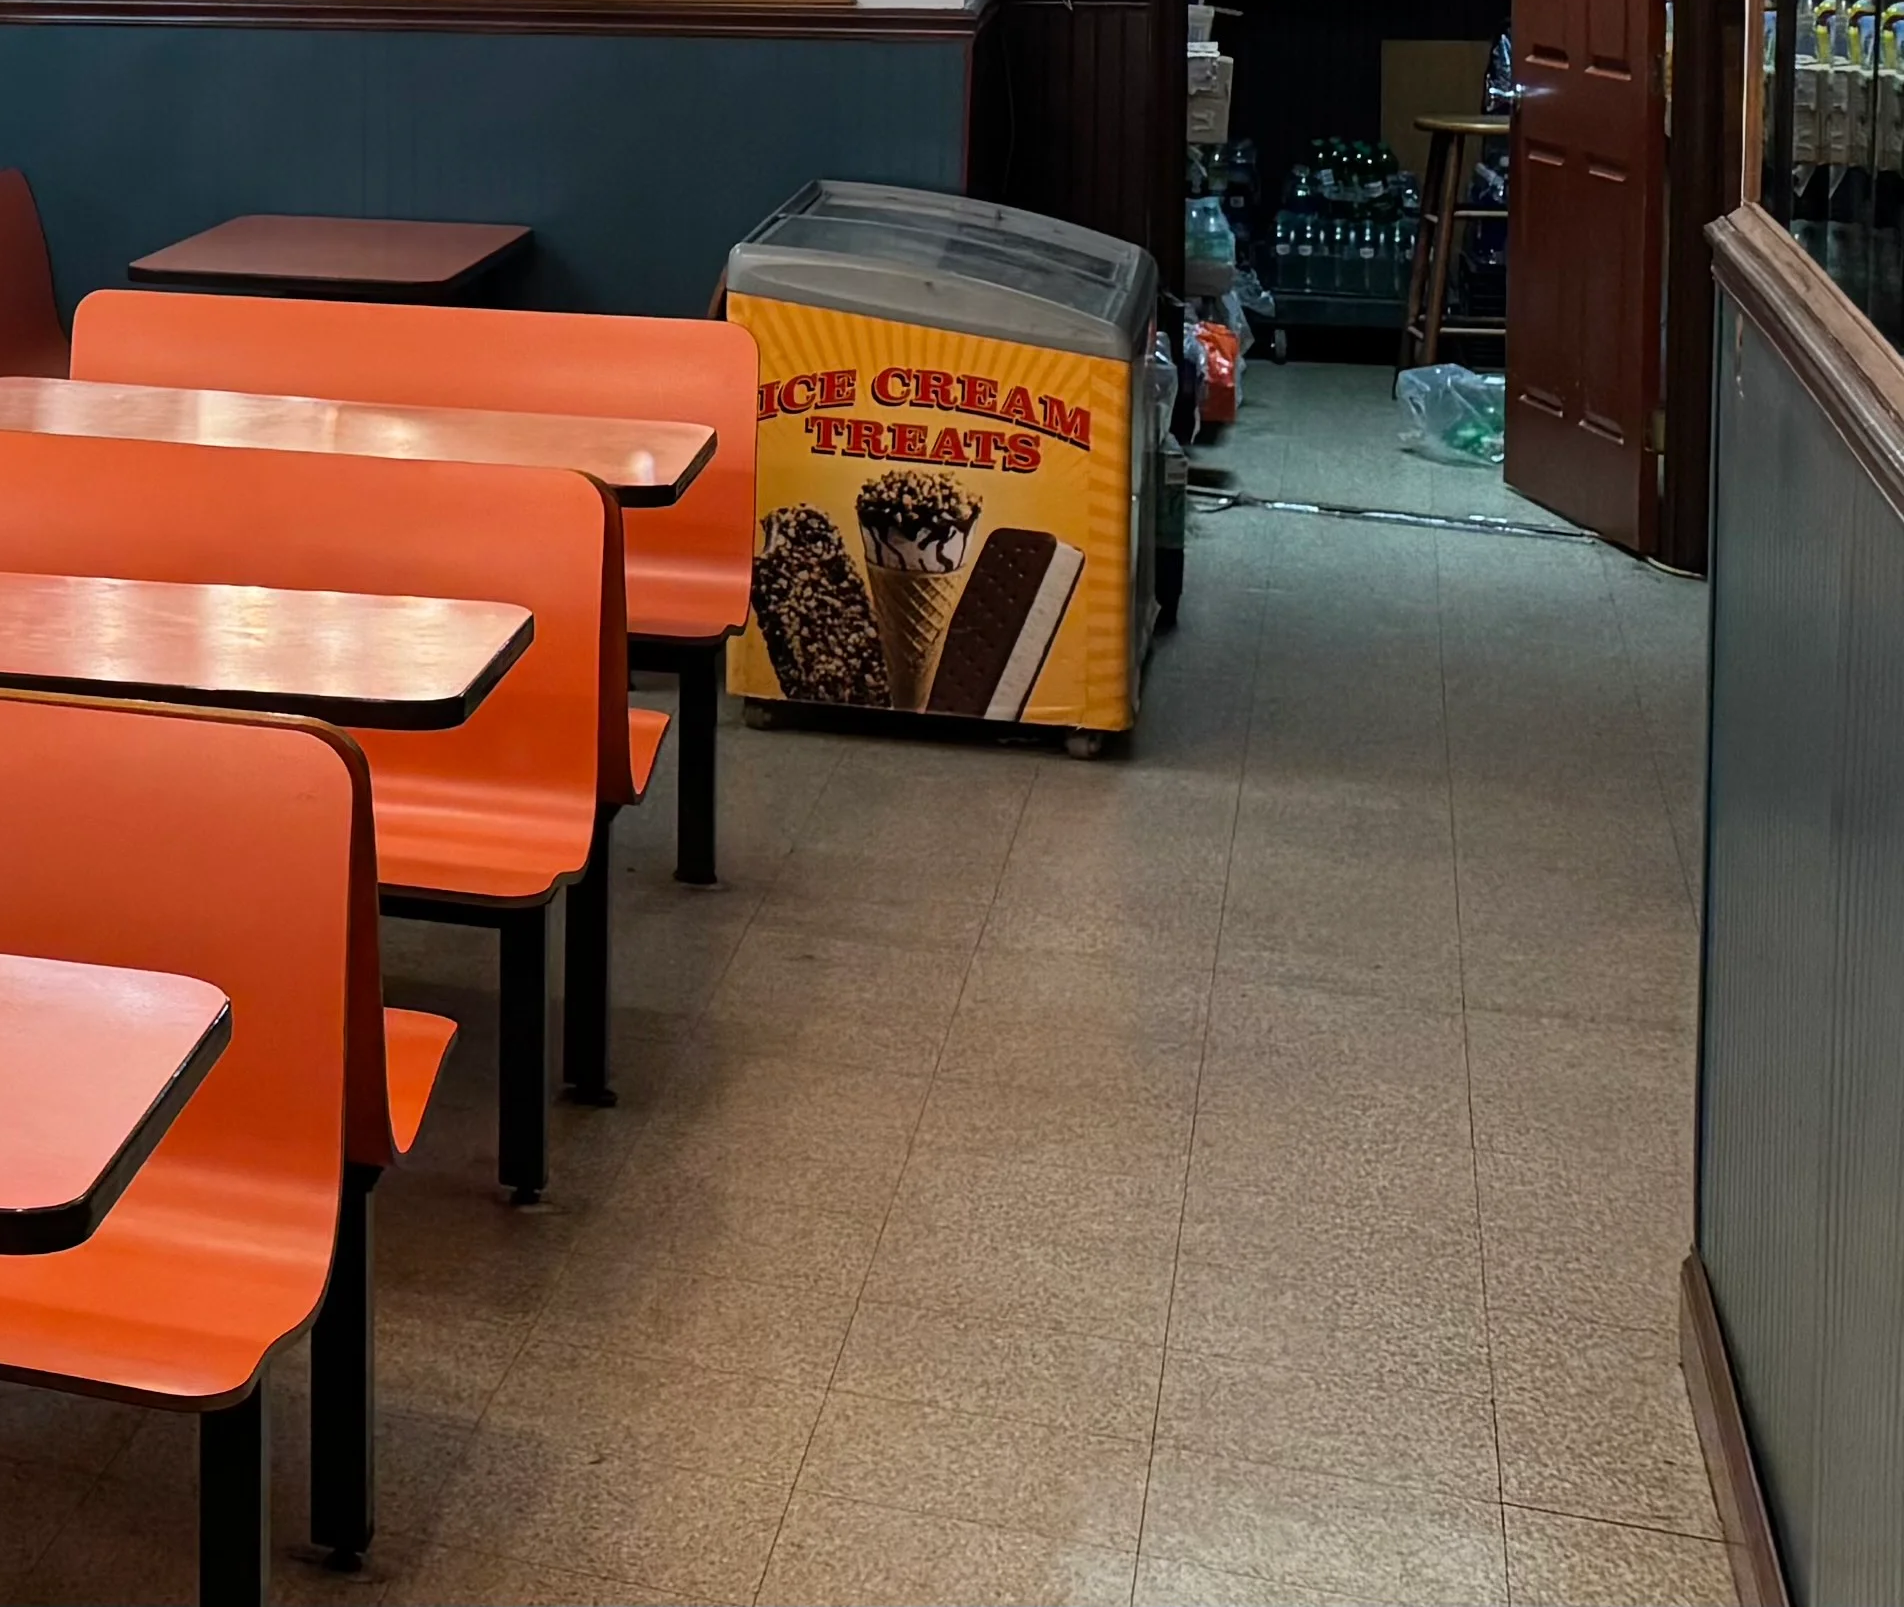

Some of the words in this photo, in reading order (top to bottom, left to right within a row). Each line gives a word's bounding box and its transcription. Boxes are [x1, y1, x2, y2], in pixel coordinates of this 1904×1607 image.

[758, 368, 856, 422] ICE
[871, 367, 1092, 452] CREAM
[805, 415, 1042, 474] TREATS
